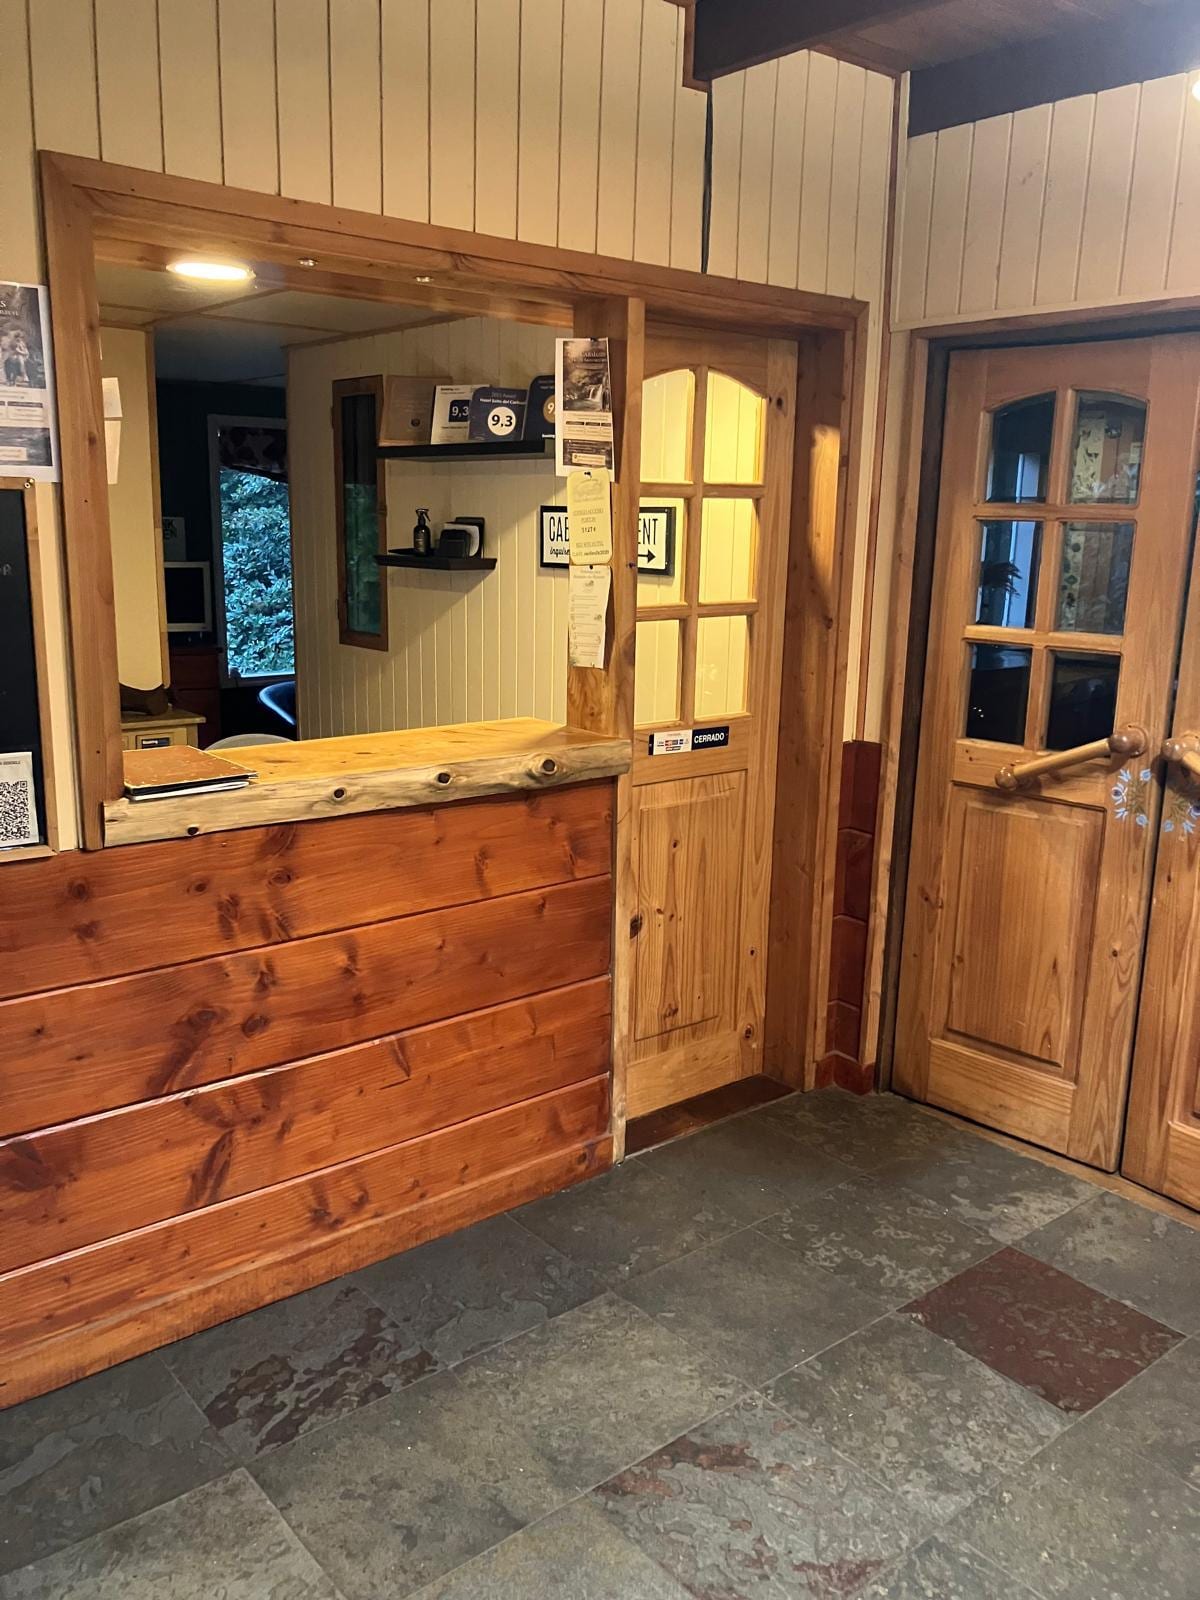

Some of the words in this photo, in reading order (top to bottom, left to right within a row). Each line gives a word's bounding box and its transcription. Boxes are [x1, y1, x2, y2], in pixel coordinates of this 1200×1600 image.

[452, 405, 469, 418] 9,3
[491, 414, 513, 427] 9,3
[694, 732, 725, 744] CERRADO
